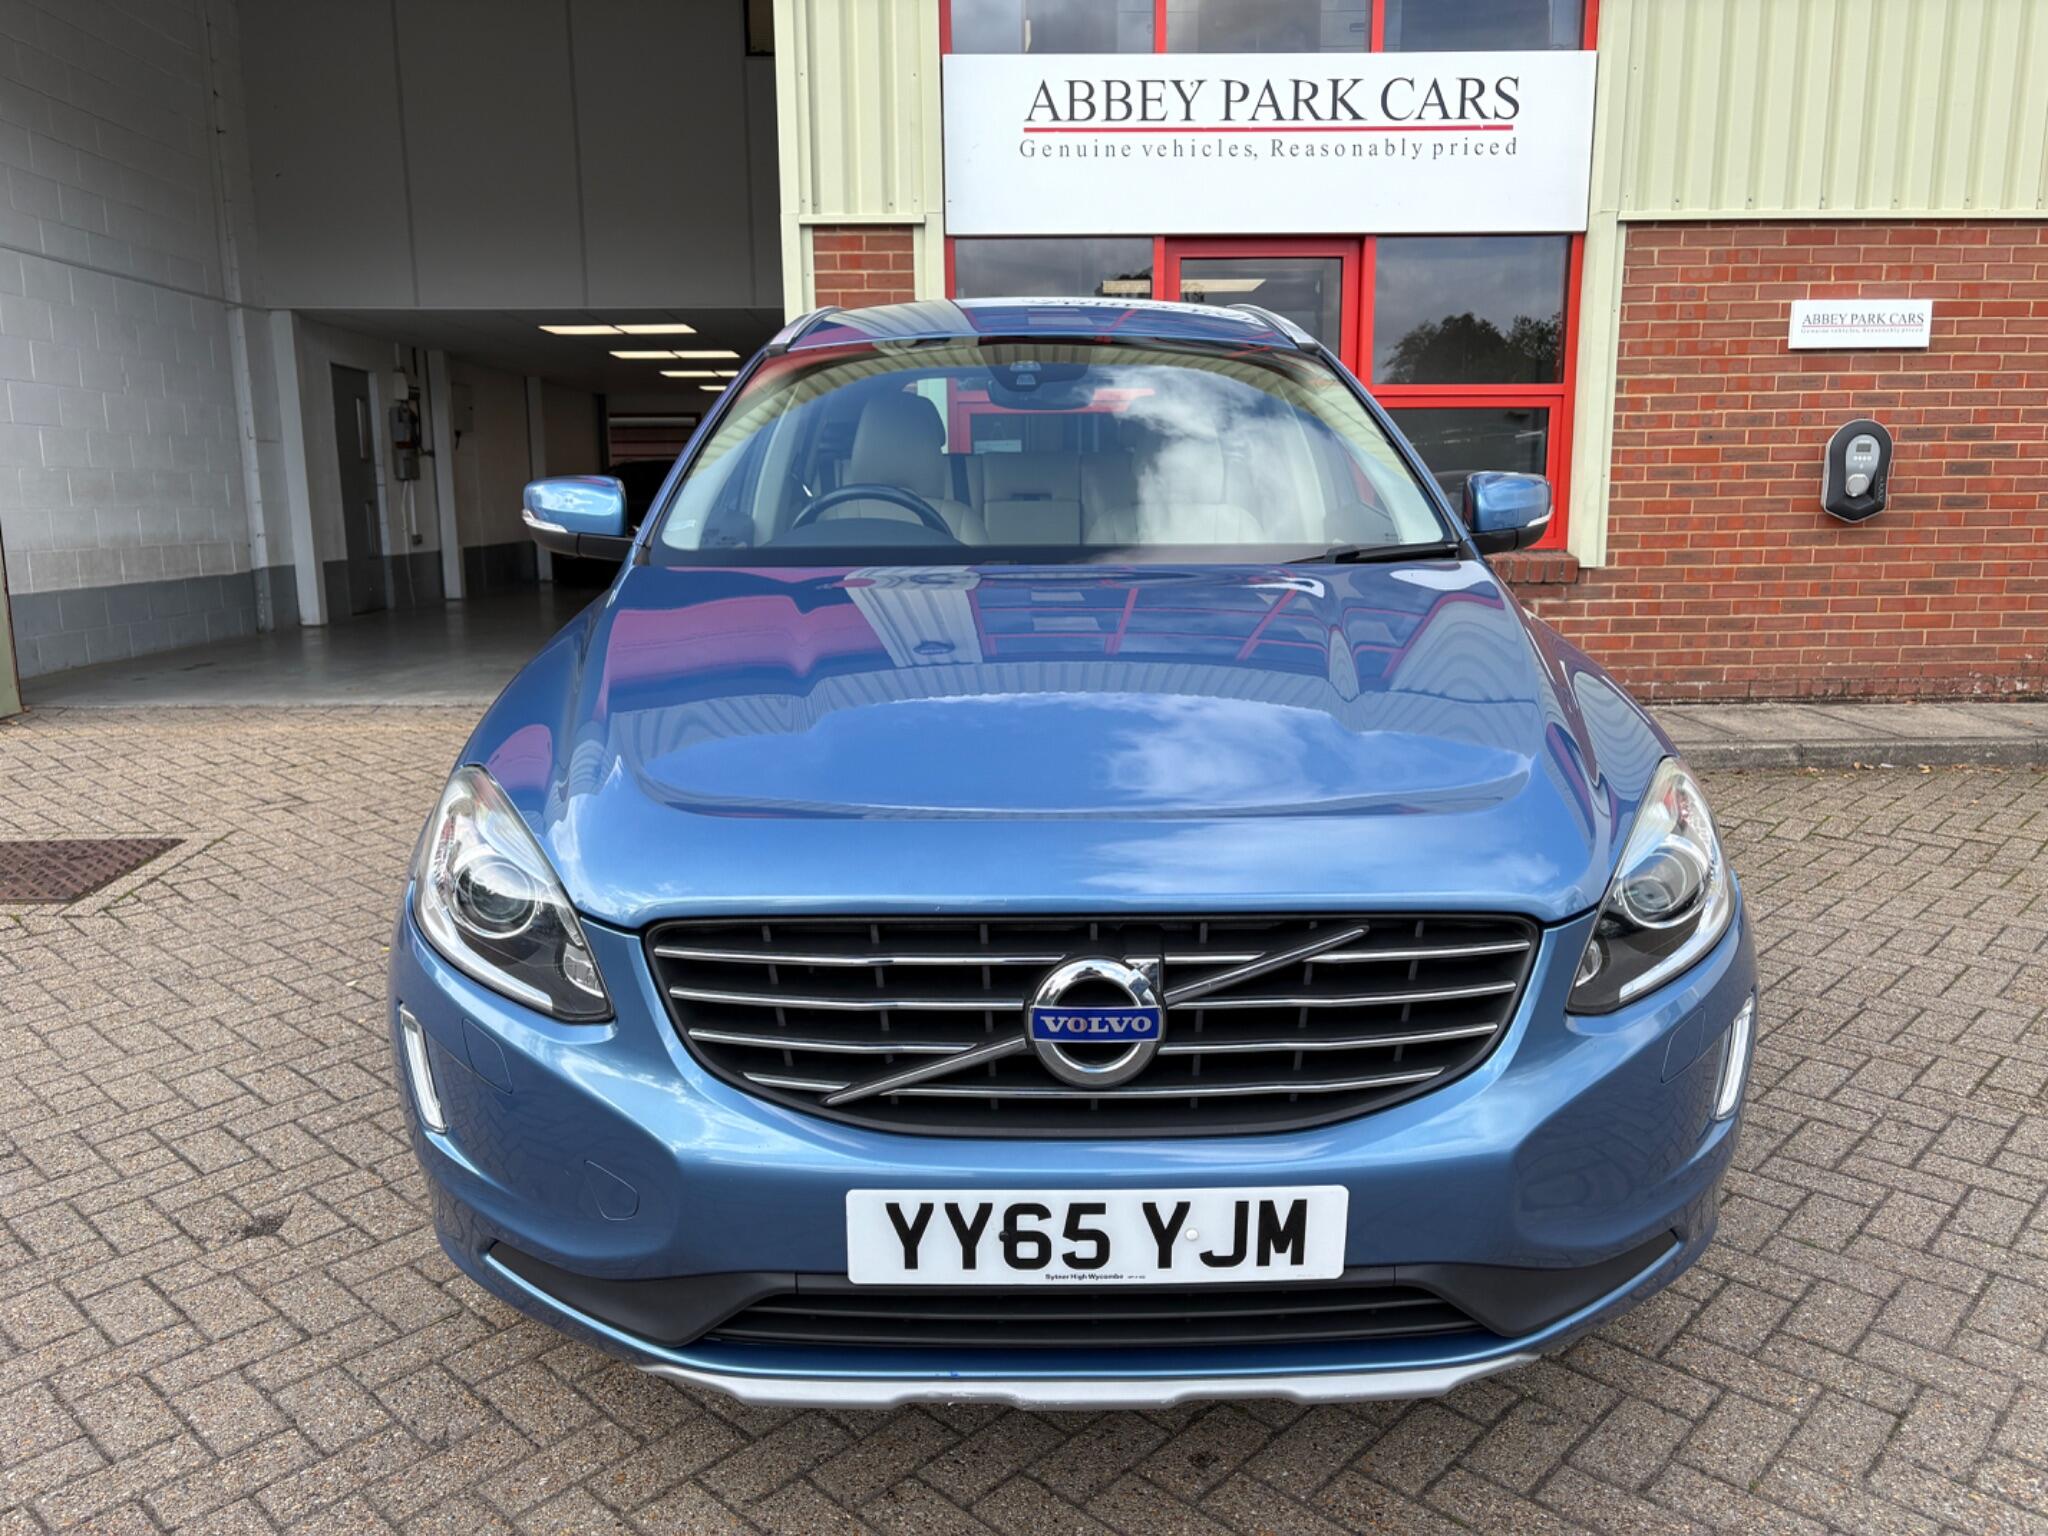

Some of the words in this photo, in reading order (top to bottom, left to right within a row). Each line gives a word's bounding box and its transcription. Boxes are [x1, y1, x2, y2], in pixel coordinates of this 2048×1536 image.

[1024, 79, 1205, 122] ABBEY
[1222, 78, 1366, 121] PARK
[1380, 76, 1521, 121] CARS
[1019, 139, 1132, 159] Genuine
[1142, 138, 1259, 160] vehicles,
[1271, 137, 1423, 161] Reasonably
[1432, 136, 1518, 160] priced
[1802, 313, 1848, 325] ABBEY
[1850, 313, 1886, 325] PARK
[1889, 312, 1925, 324] CARS
[1040, 1016, 1152, 1033] VOLVO
[885, 1202, 1111, 1271] YY65
[1142, 1198, 1308, 1269] YJM
